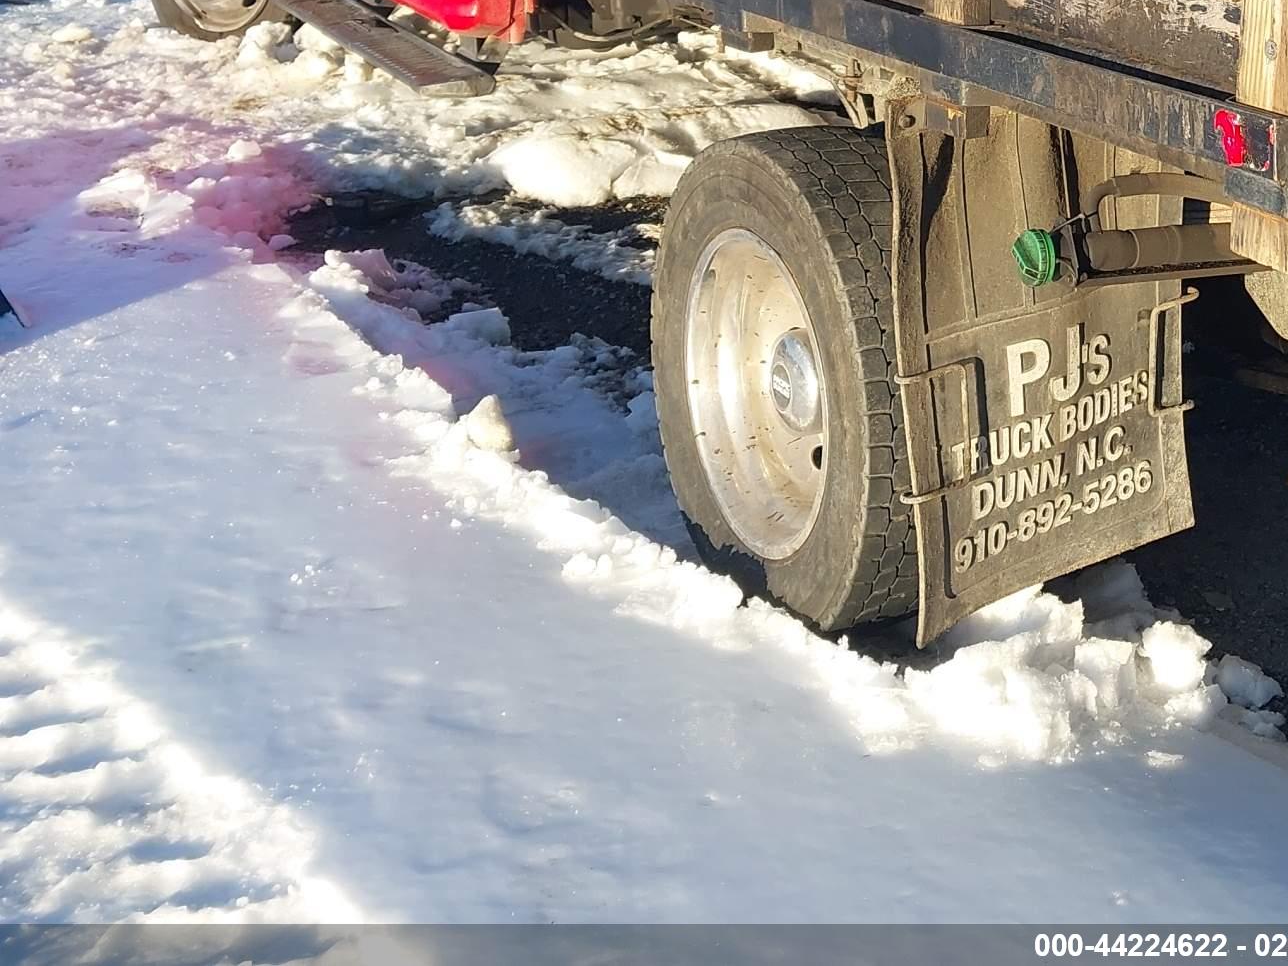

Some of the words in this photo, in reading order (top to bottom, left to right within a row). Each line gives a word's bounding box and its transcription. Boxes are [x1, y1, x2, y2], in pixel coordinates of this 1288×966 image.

[951, 414, 1054, 481] TRUCK
[1059, 371, 1149, 444] BODIES
[972, 451, 1069, 520] DUNN,
[1076, 426, 1134, 476] N.C.
[954, 461, 1153, 574] 910-892-5286
